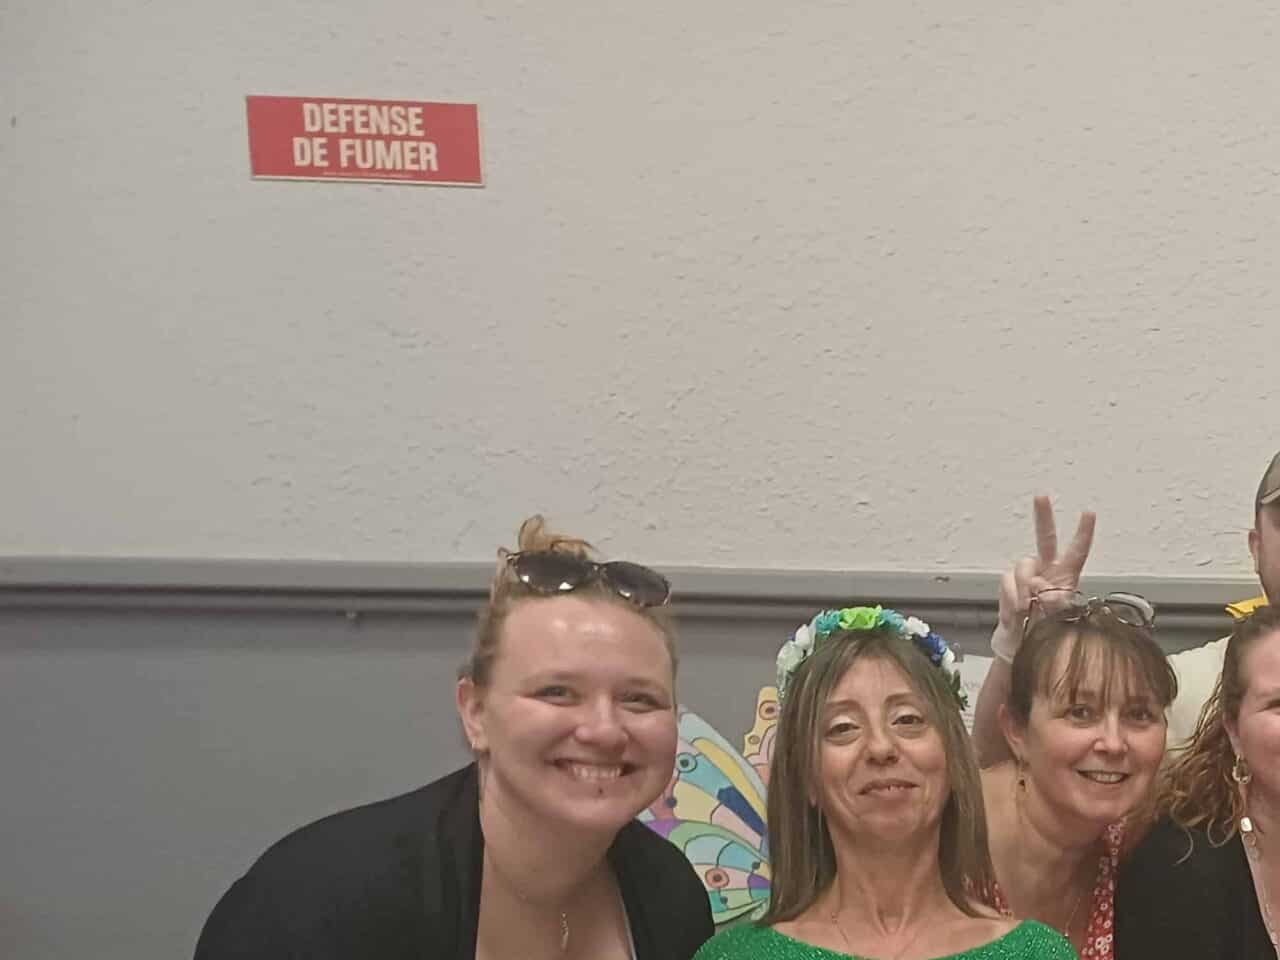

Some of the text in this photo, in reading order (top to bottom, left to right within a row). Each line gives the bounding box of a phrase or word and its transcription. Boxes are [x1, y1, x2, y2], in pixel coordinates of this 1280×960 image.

[302, 102, 425, 137] DEFENSE
[292, 136, 439, 172] DE FUMER
